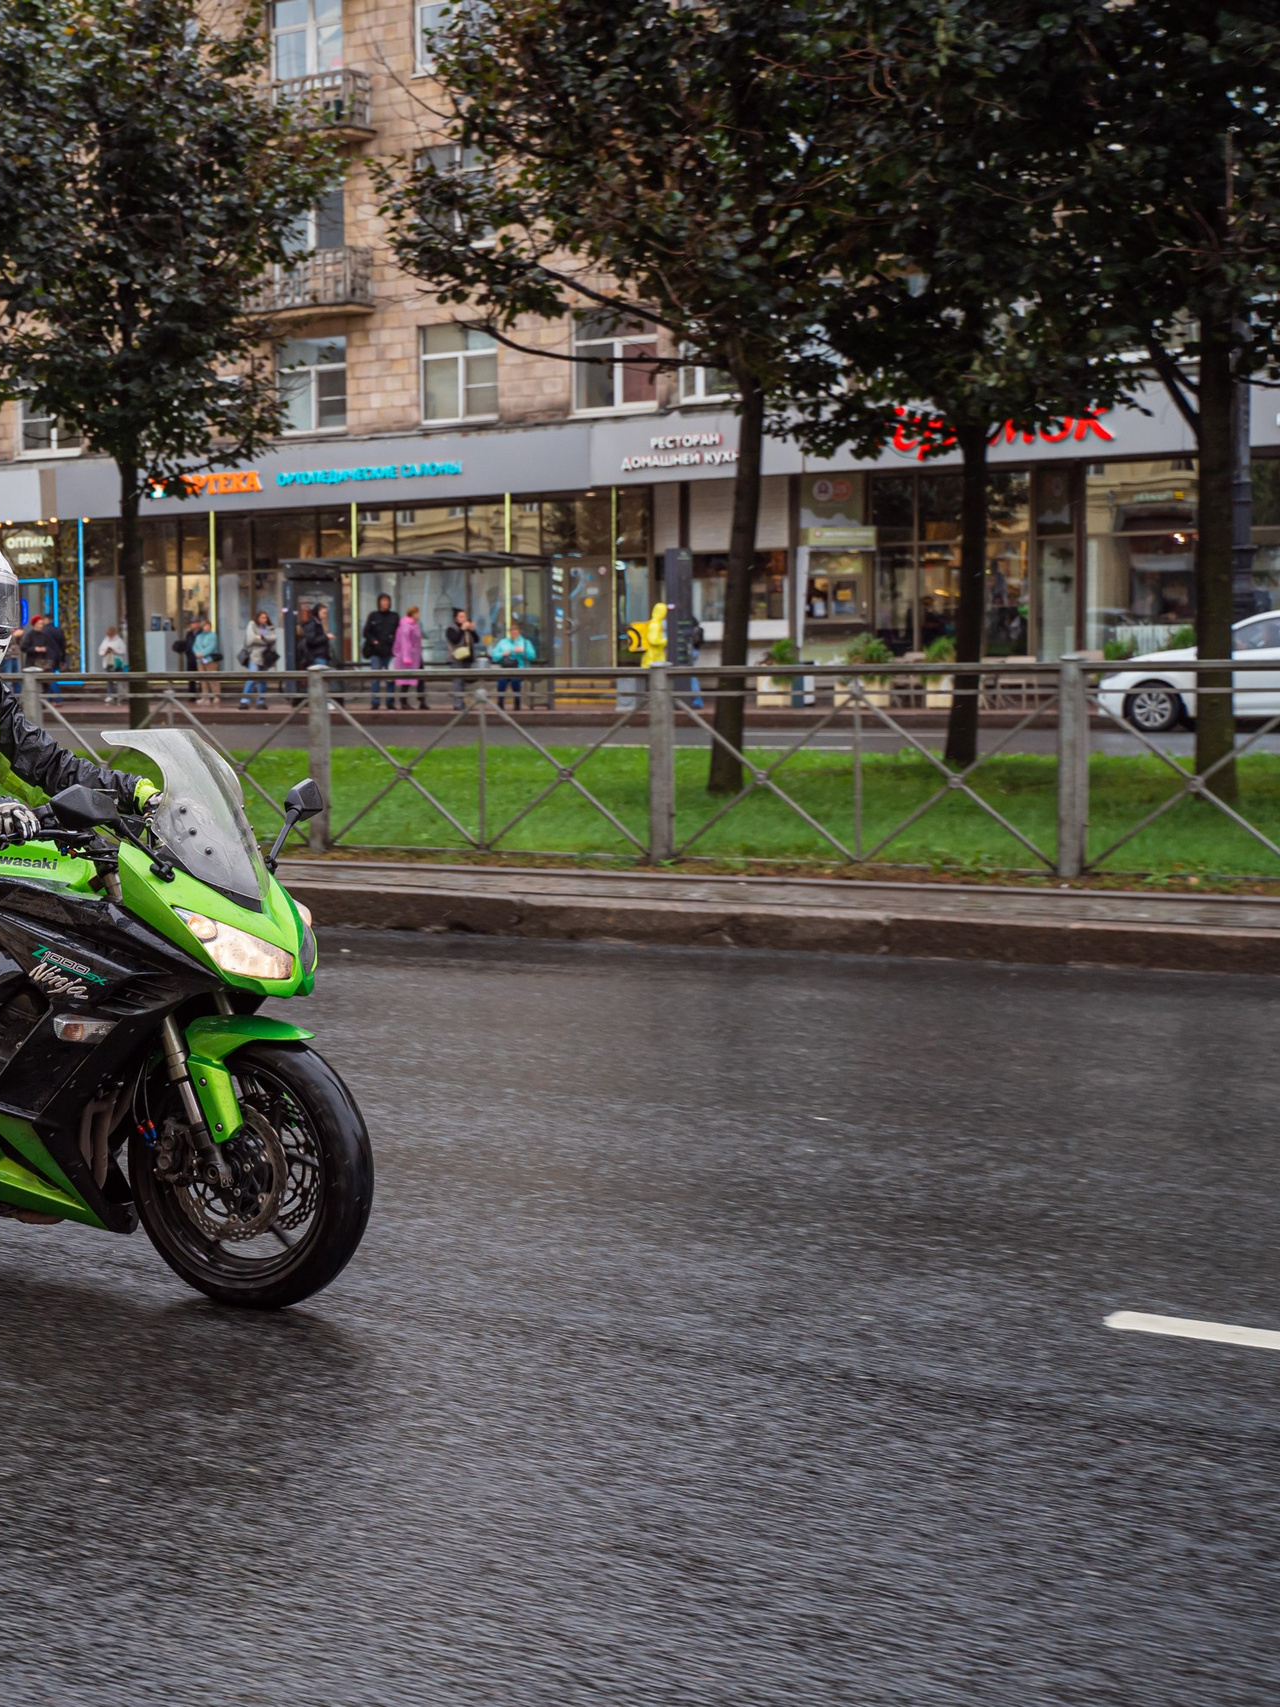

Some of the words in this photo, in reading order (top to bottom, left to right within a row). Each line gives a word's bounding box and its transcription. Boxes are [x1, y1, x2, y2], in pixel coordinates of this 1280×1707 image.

[650, 433, 722, 449] РЕСТОРАН
[621, 451, 702, 472] ДОМАШНЕЙ
[276, 464, 399, 486] ОРТОПЕДИЧЕСКИЕ
[400, 460, 462, 478] САЛОНЫ
[5, 535, 54, 549] ОПТИКА
[28, 962, 89, 1000] Ninja
